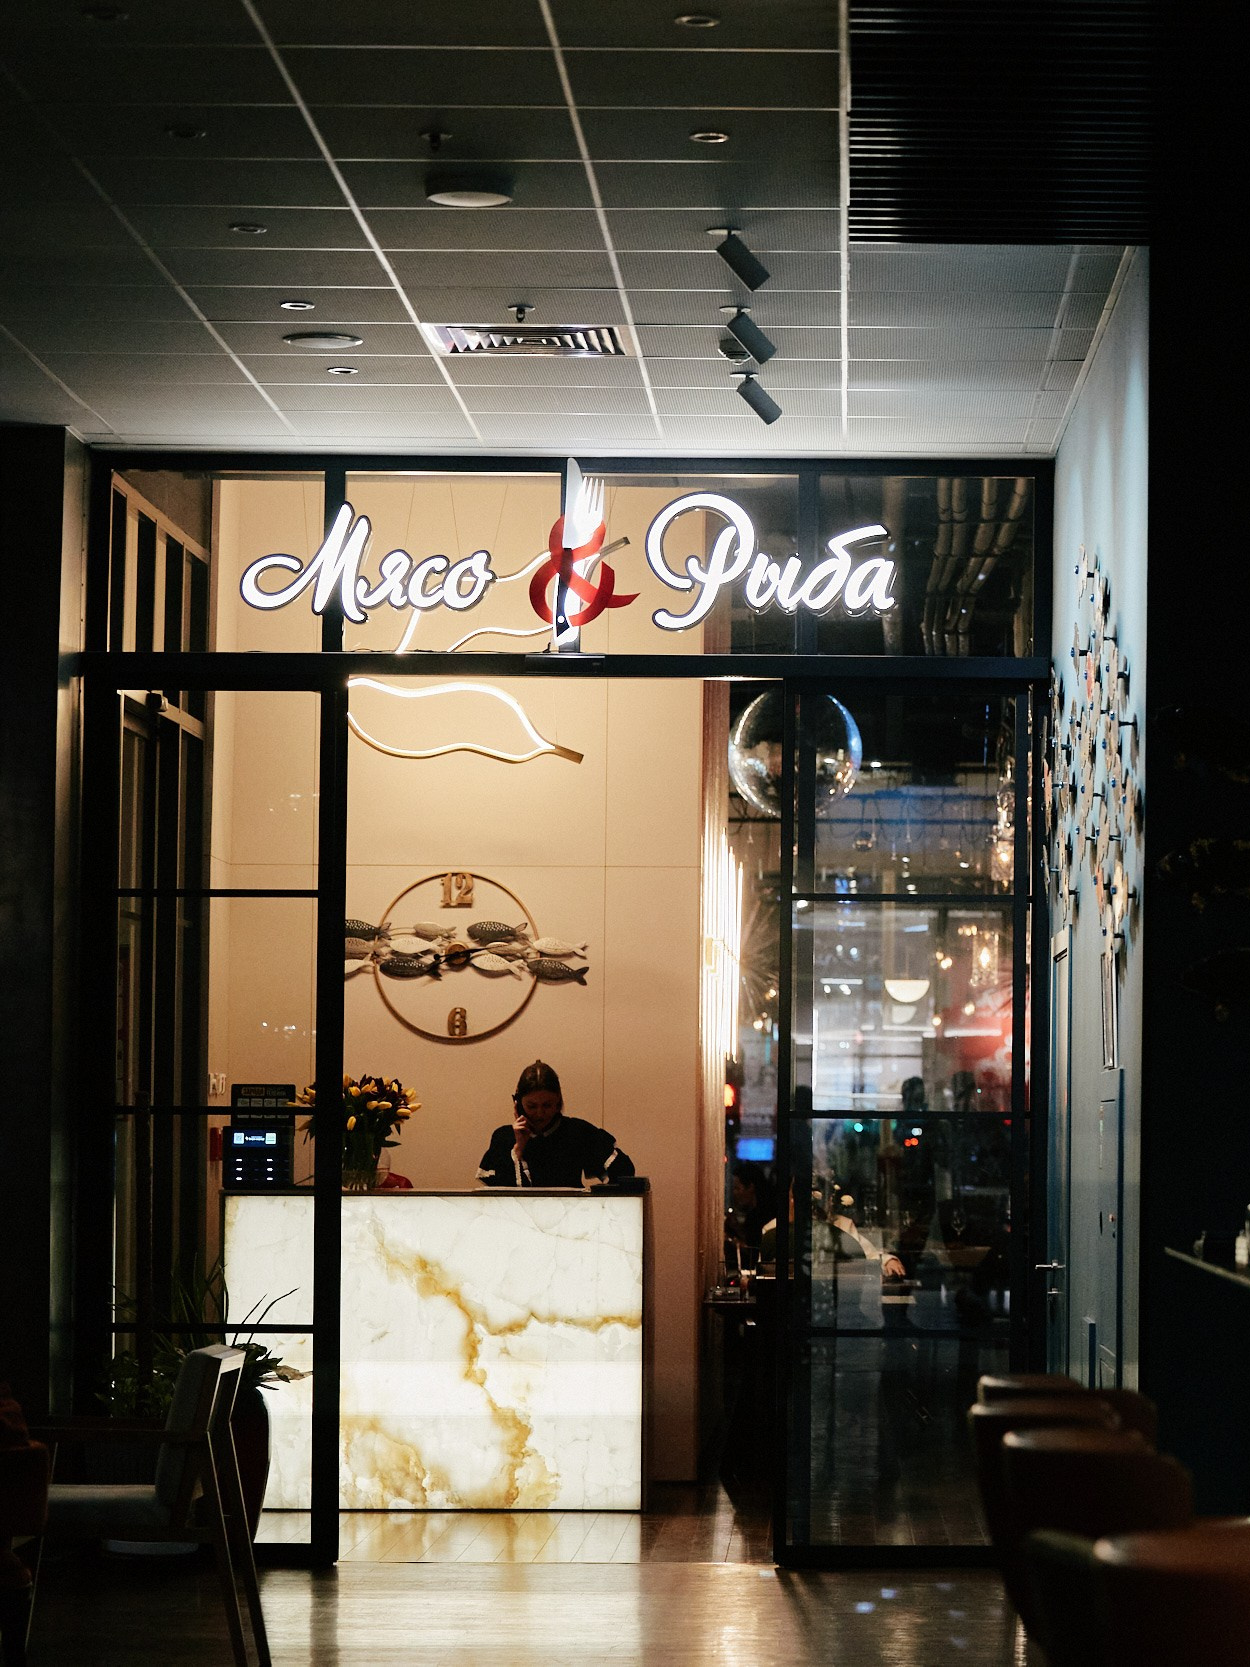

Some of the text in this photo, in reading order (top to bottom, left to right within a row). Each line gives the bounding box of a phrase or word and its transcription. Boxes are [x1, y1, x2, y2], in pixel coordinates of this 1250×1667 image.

[240, 491, 898, 632] Мясо & Рыба
[440, 872, 474, 908] 12
[447, 1006, 468, 1037] 6
